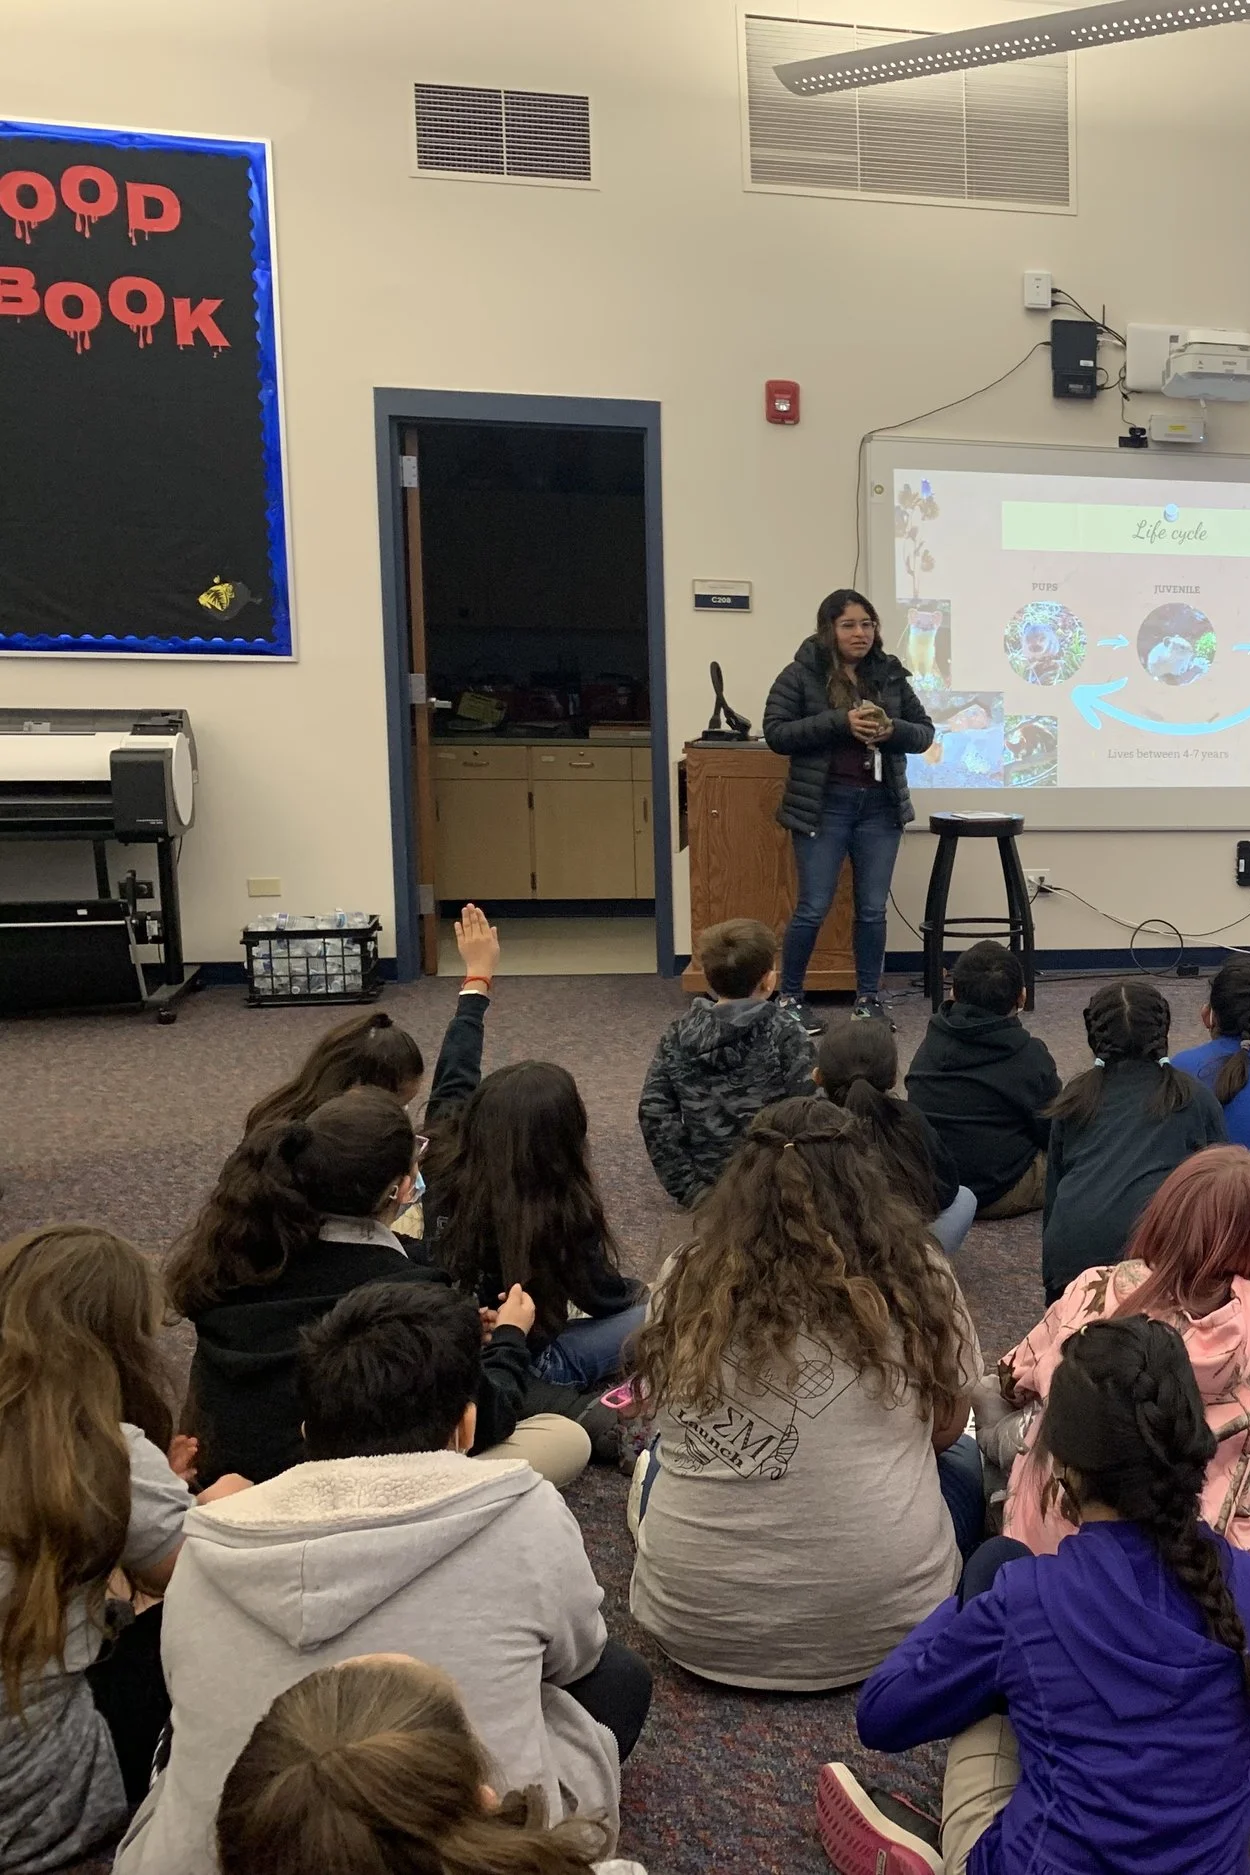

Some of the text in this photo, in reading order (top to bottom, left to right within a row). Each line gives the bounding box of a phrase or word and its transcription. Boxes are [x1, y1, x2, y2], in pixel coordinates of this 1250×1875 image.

[1132, 519, 1208, 546] Life cycle
[1031, 582, 1058, 591] PUPS
[1153, 584, 1201, 595] JUVENILE
[1108, 748, 1230, 762] Lives between 4-7 years
[676, 1408, 744, 1469] Launch
